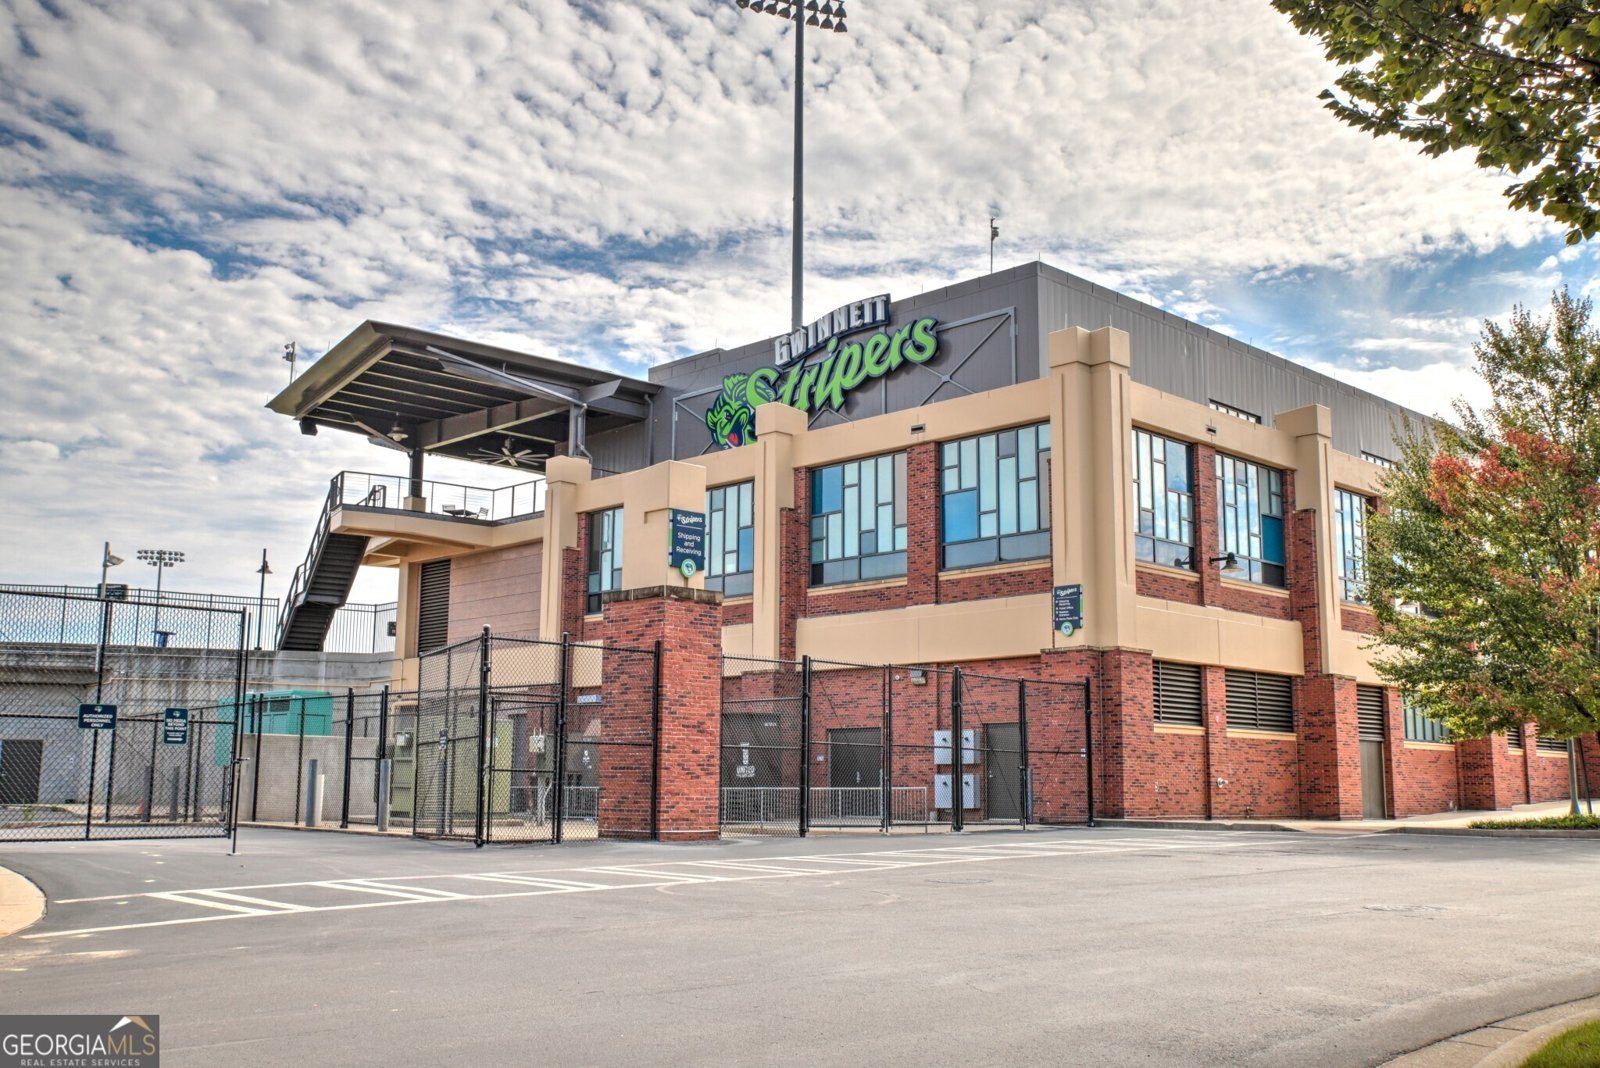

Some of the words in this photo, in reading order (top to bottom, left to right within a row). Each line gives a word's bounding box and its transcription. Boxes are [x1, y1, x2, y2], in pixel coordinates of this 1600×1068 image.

[774, 296, 887, 366] GWINNETT
[745, 315, 939, 416] Stripers
[676, 546, 702, 557] Receiving
[677, 531, 701, 542] Shipping
